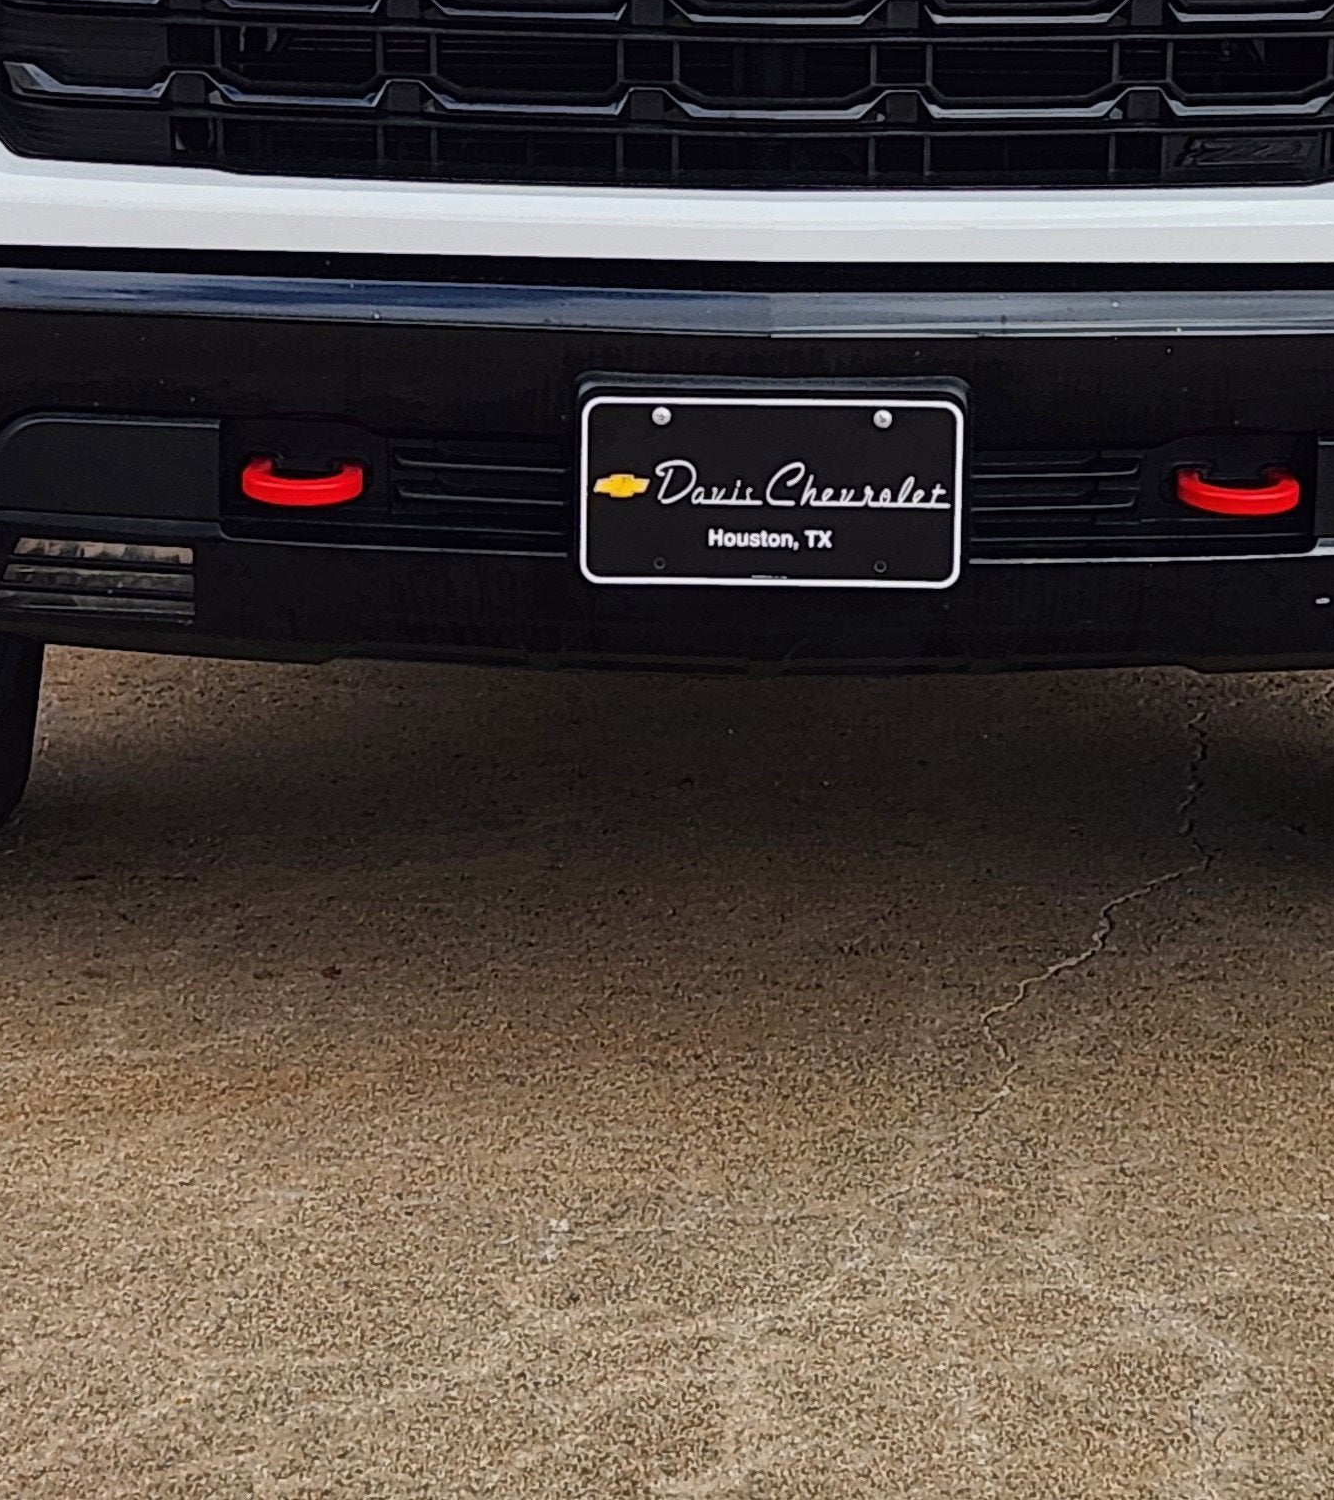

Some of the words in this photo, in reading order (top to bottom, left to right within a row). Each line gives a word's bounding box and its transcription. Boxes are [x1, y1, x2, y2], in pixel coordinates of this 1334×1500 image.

[654, 459, 763, 505] Davis
[765, 461, 952, 509] Chevrolet
[707, 528, 799, 551] Houston,
[804, 530, 833, 548] TX
